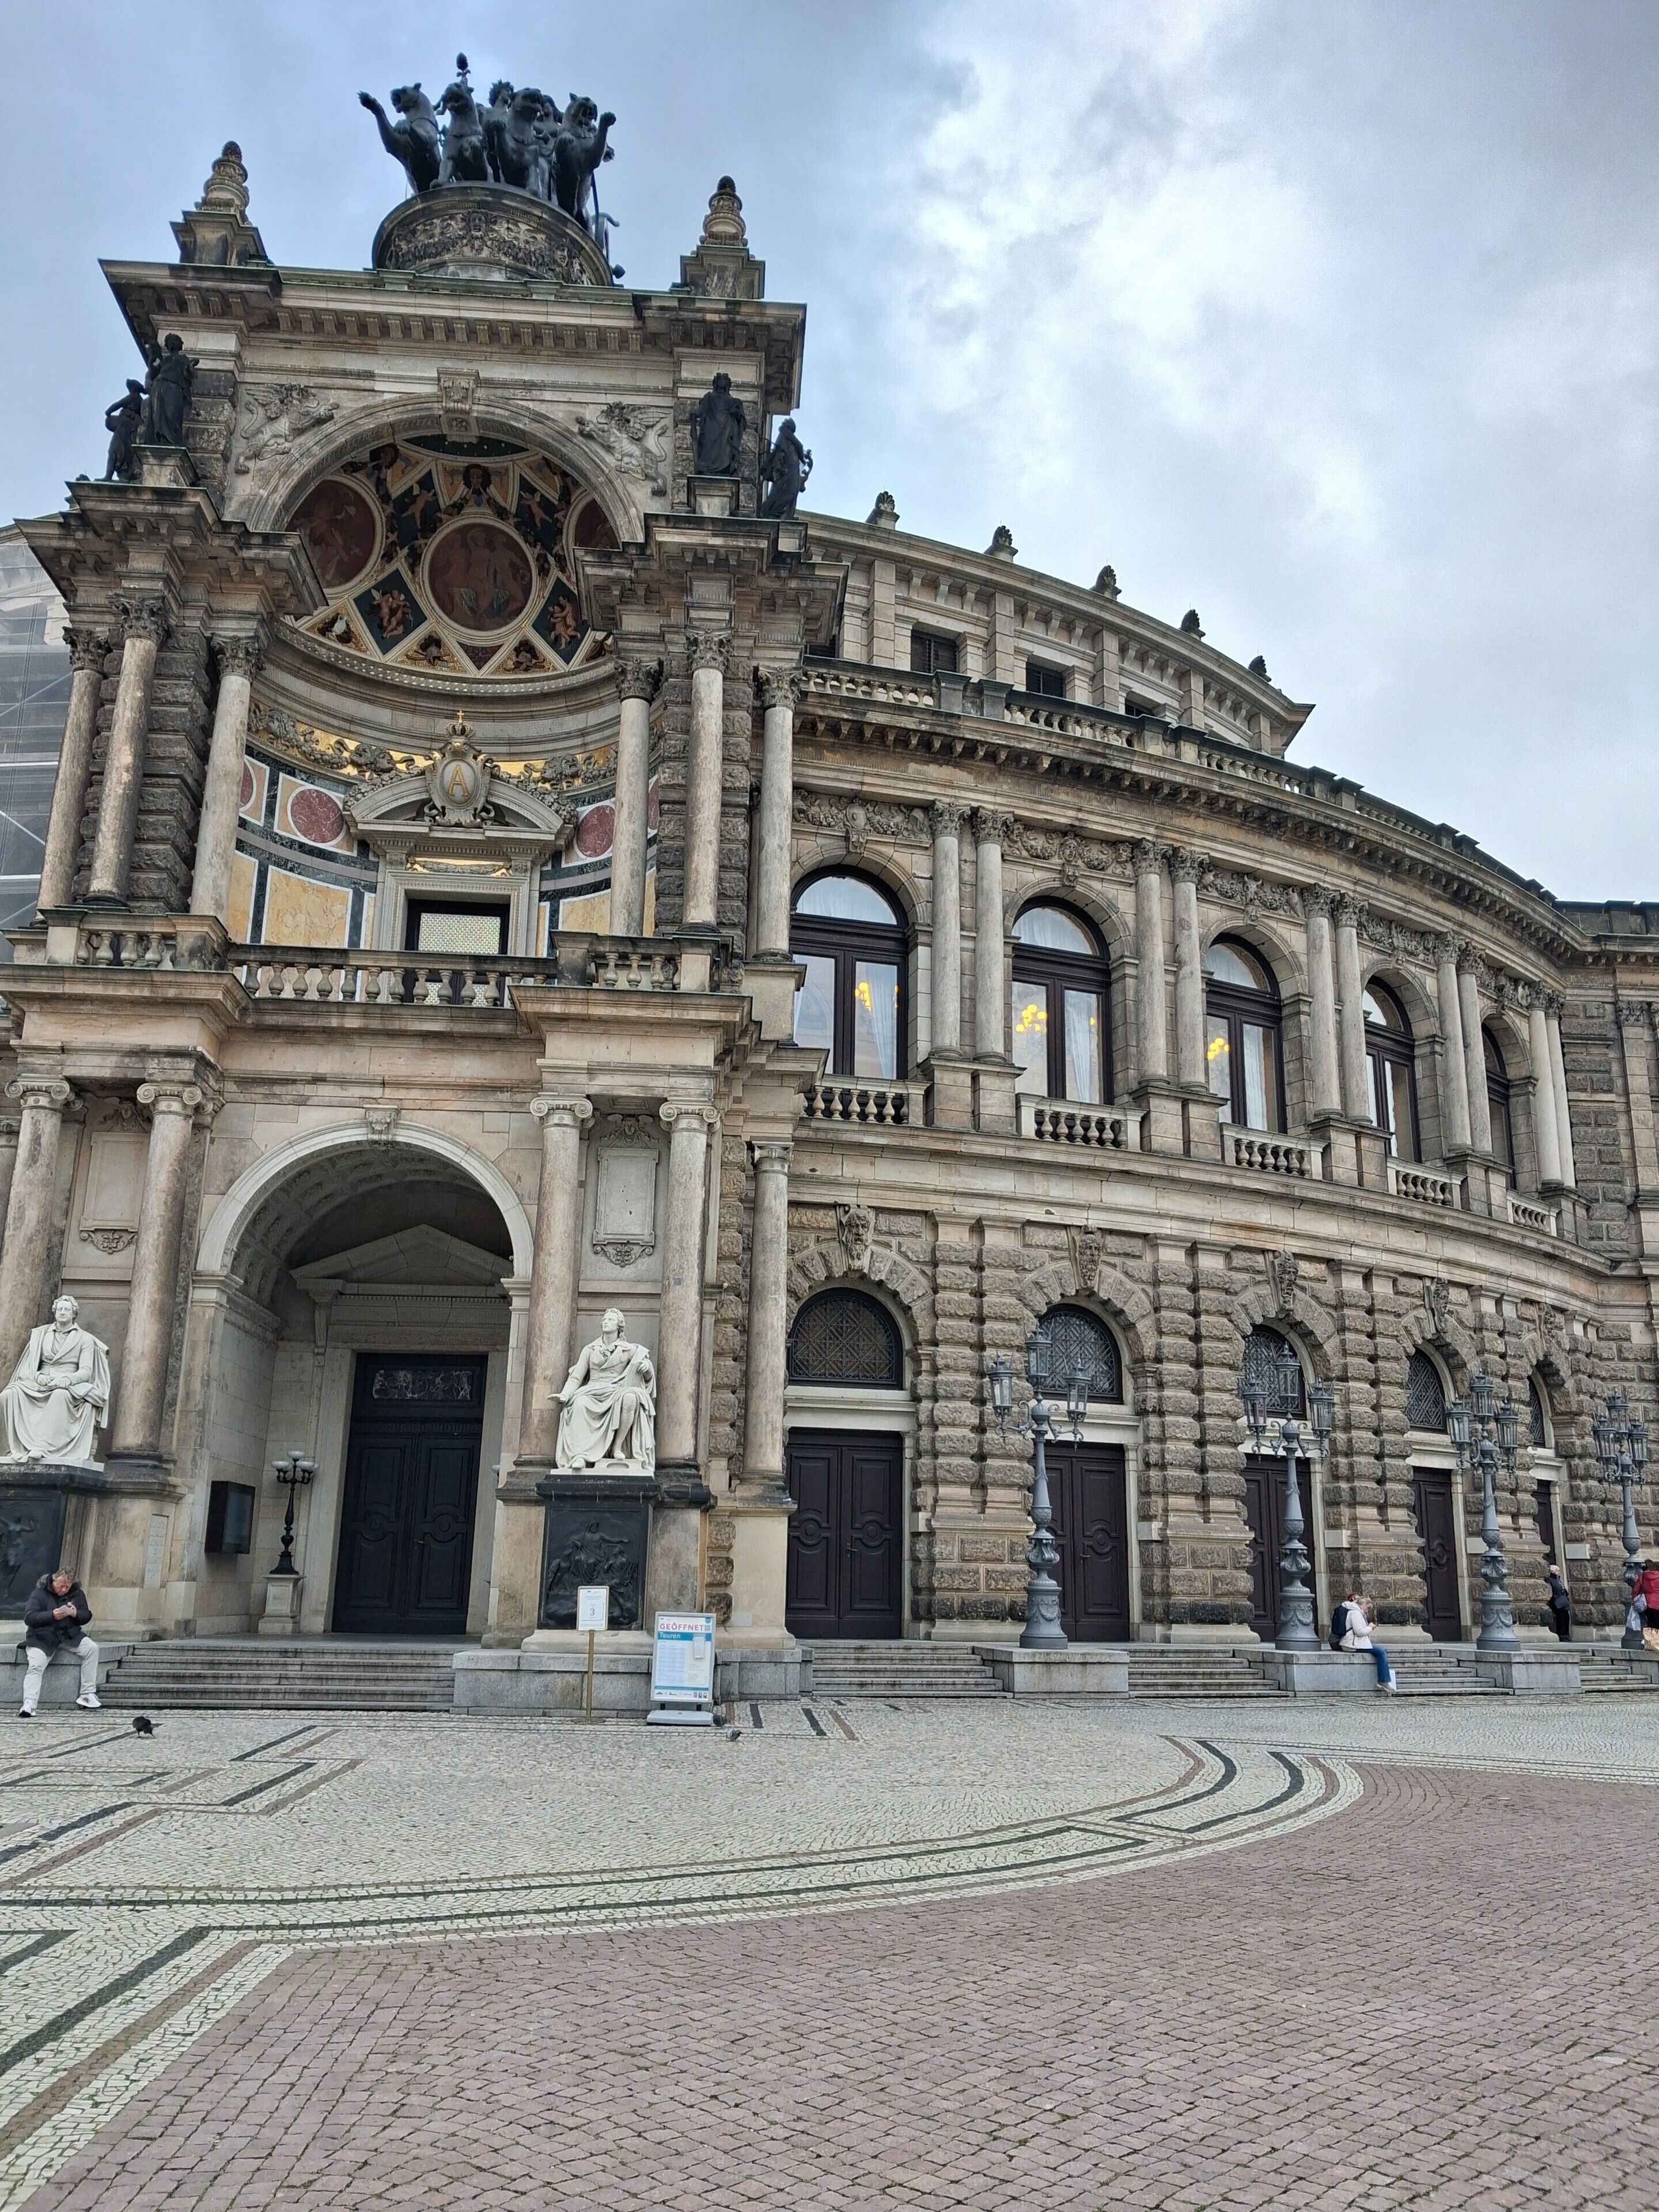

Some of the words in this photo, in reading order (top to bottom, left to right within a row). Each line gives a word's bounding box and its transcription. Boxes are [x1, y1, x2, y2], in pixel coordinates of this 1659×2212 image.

[448, 764, 469, 797] A
[590, 1608, 595, 1616] 3
[660, 1622, 703, 1631] GEÖFFNET
